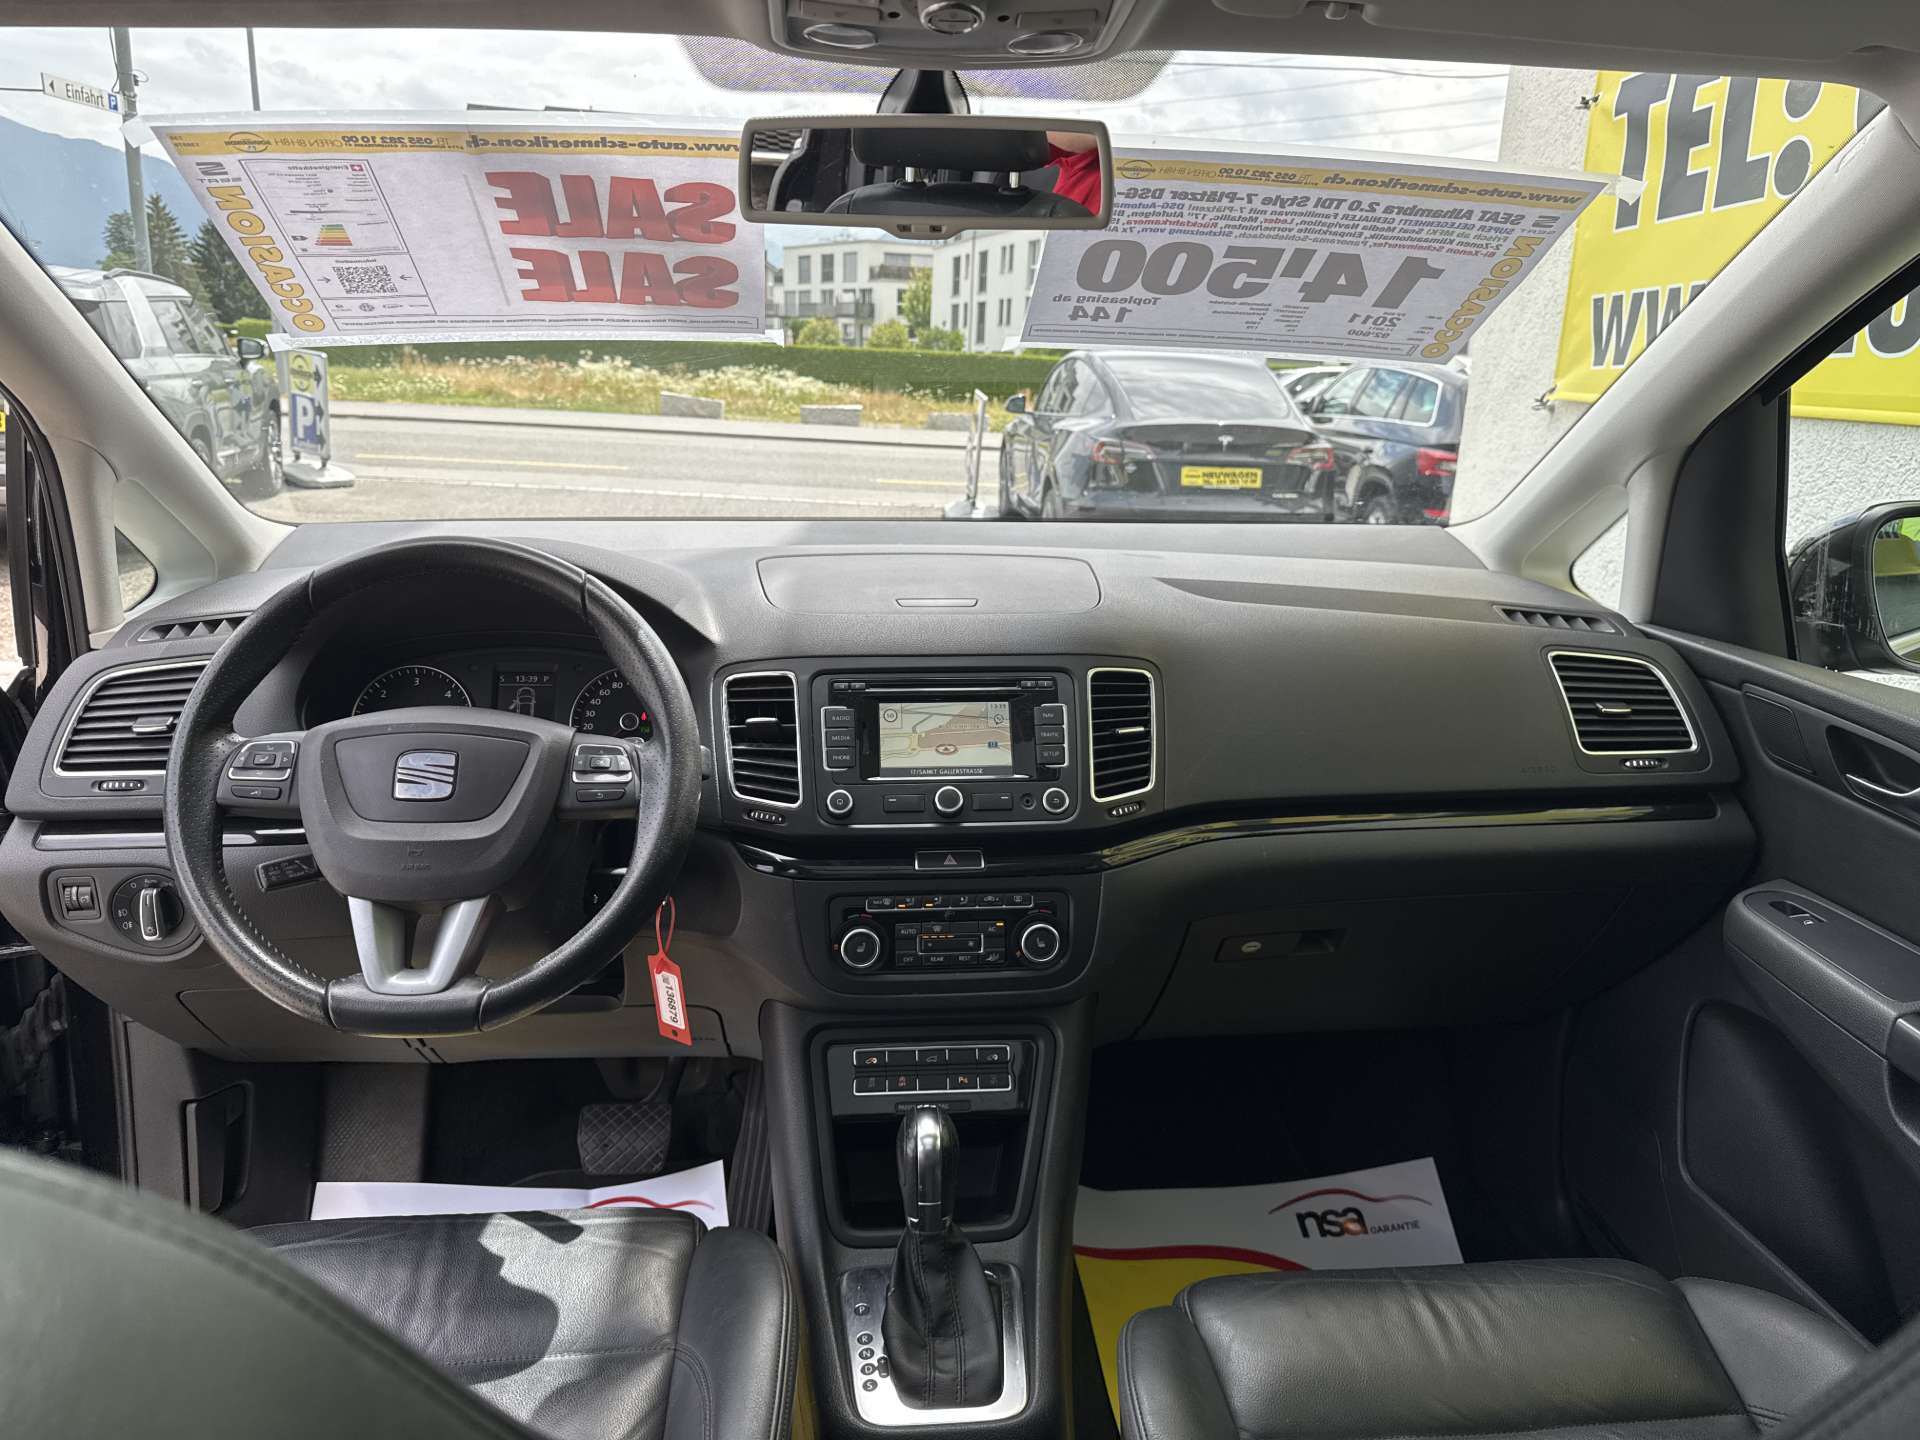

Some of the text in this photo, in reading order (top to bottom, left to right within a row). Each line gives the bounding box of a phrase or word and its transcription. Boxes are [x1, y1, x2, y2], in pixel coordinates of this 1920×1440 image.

[65, 83, 105, 107] Einfahrt
[296, 397, 315, 441] P
[413, 677, 420, 686] 3
[612, 681, 624, 690] 80
[380, 690, 388, 698] 2
[444, 690, 453, 698] 4
[600, 689, 611, 698] 60
[590, 698, 602, 706] 40
[584, 710, 596, 718] 30
[583, 723, 595, 731] 20
[901, 928, 917, 936] AUTO
[666, 985, 679, 1024] 136879
[1296, 1206, 1421, 1239] nsa GARANTIE
[859, 1305, 866, 1315] P
[861, 1335, 870, 1343] R
[863, 1349, 871, 1358] N
[865, 1365, 872, 1373] D
[866, 1381, 874, 1390] S
